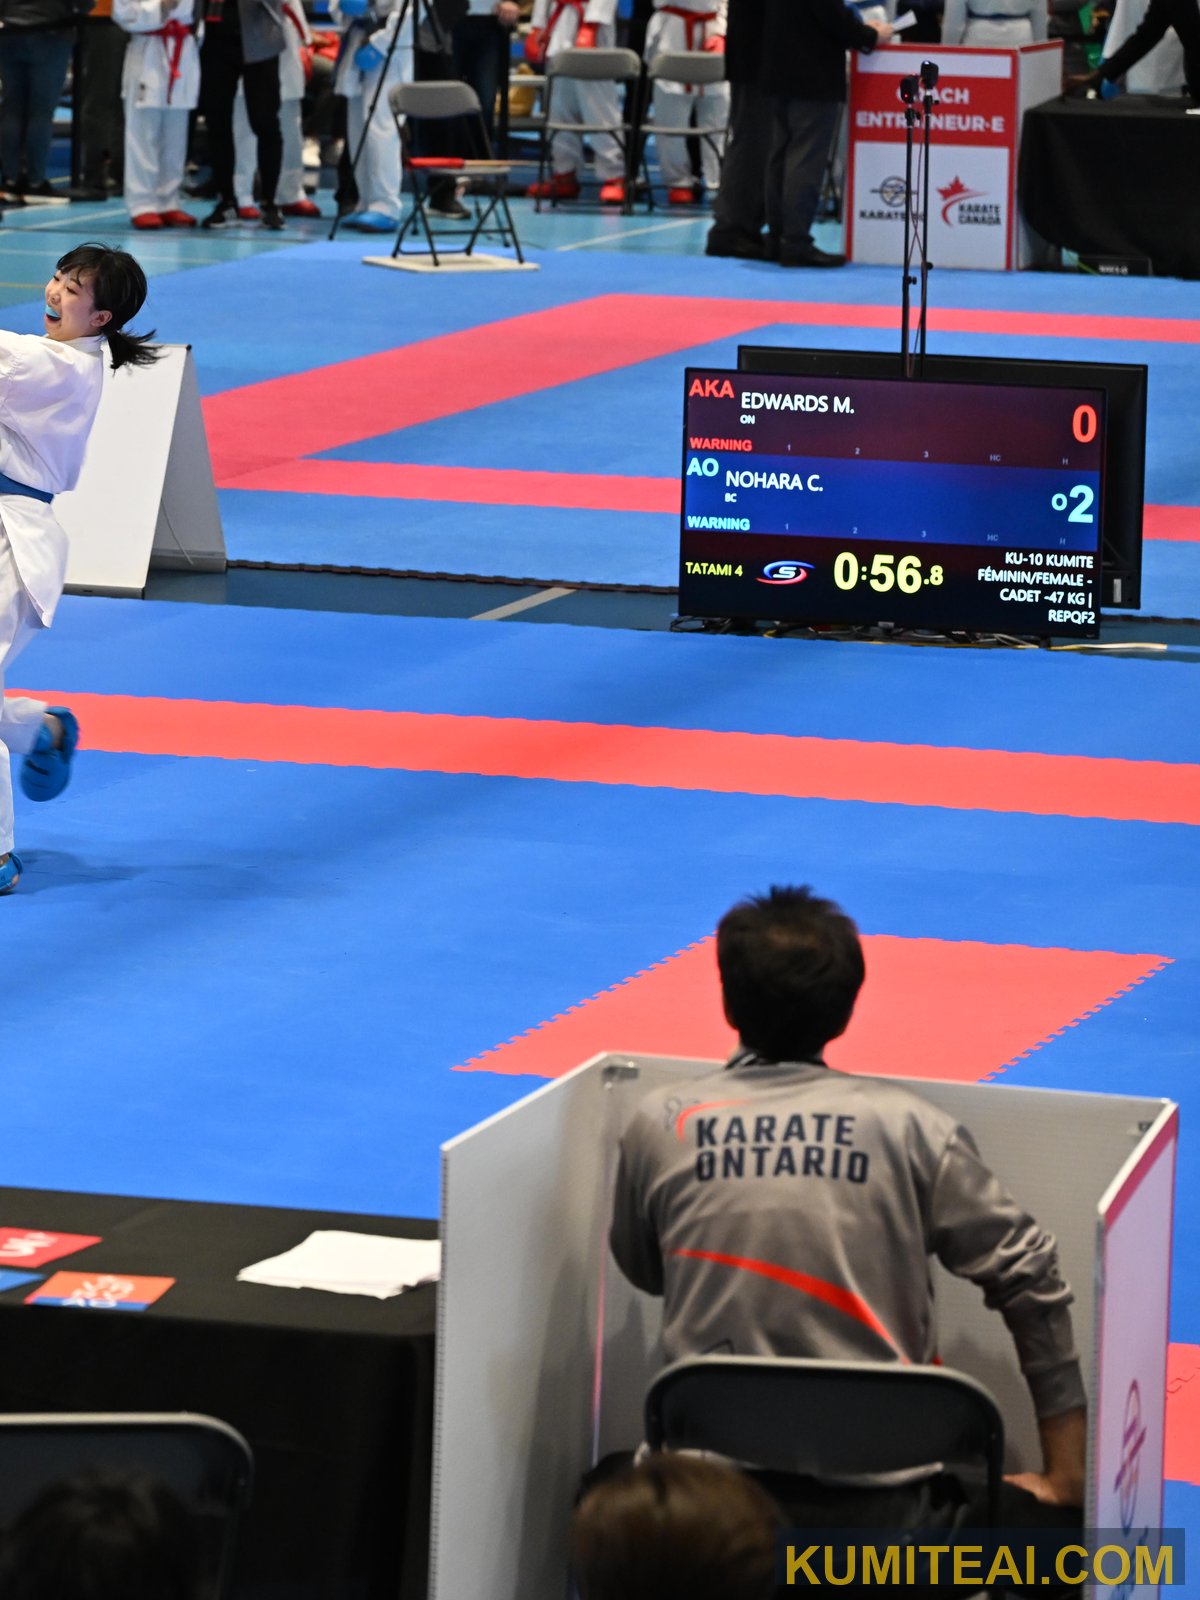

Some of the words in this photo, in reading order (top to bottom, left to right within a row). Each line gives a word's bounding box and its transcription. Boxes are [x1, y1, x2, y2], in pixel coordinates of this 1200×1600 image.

[959, 203, 1000, 214] KARATE
[958, 214, 1001, 225] CANADA
[689, 379, 735, 398] AKA
[741, 392, 828, 413] EDWARDS
[833, 396, 855, 414] M.
[740, 415, 755, 424] ON
[1072, 404, 1097, 443] 0
[690, 437, 752, 451] WARNING
[687, 457, 719, 477] AO
[726, 470, 803, 490] NOHARA
[807, 474, 823, 492] C.
[725, 493, 737, 503] BC
[687, 515, 750, 531] WARNING
[921, 530, 927, 538] 3
[685, 562, 732, 576] TATAMI
[734, 565, 743, 577] 4
[1005, 552, 1043, 566] KU-10
[1046, 554, 1094, 569] KUMITE
[978, 566, 1084, 586] FÉMININ/FEMALE
[1000, 588, 1042, 602] CADET
[1044, 591, 1064, 604] -47
[1067, 592, 1085, 606] KG
[1048, 609, 1095, 625] REPQF2
[696, 1113, 856, 1147] KARATE
[695, 1146, 869, 1184] ONTARIO
